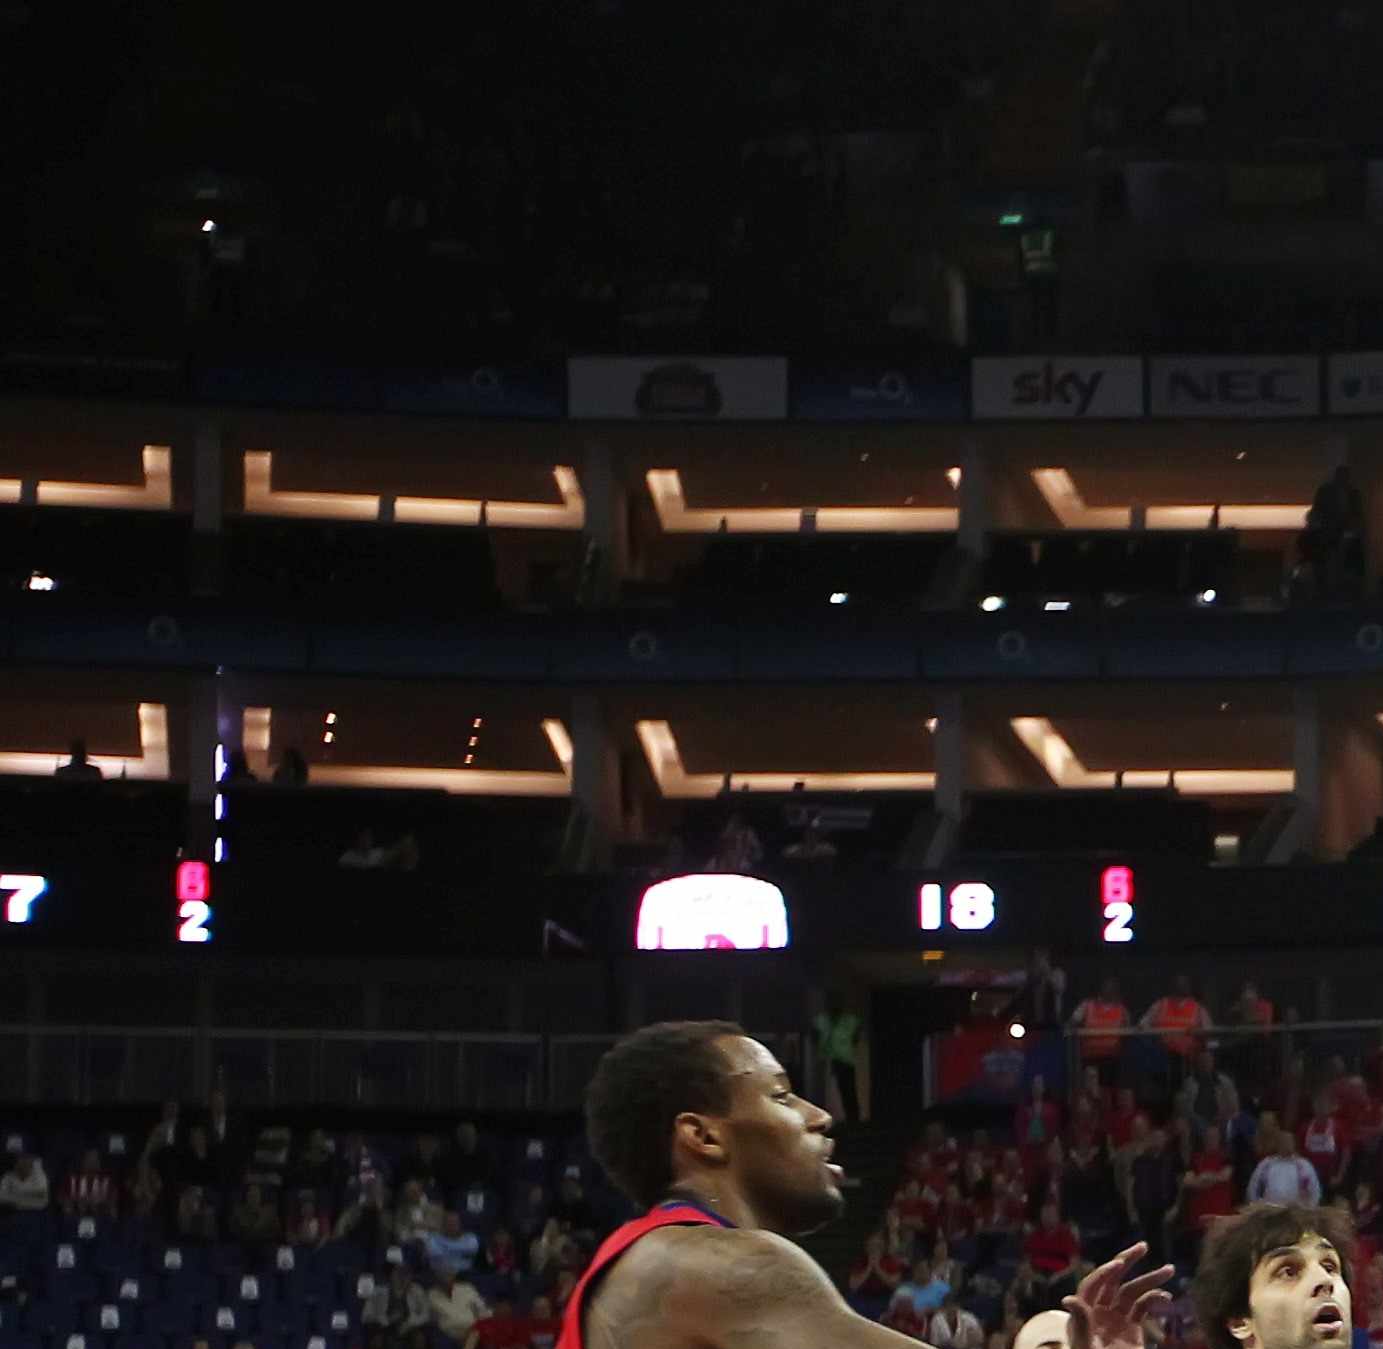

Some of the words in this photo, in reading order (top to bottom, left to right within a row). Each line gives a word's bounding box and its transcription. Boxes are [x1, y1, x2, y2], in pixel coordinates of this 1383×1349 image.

[1012, 363, 1102, 414] sky
[1168, 370, 1301, 403] NEC
[178, 900, 210, 942] 2
[920, 883, 995, 930] 18
[1104, 903, 1133, 942] 2
